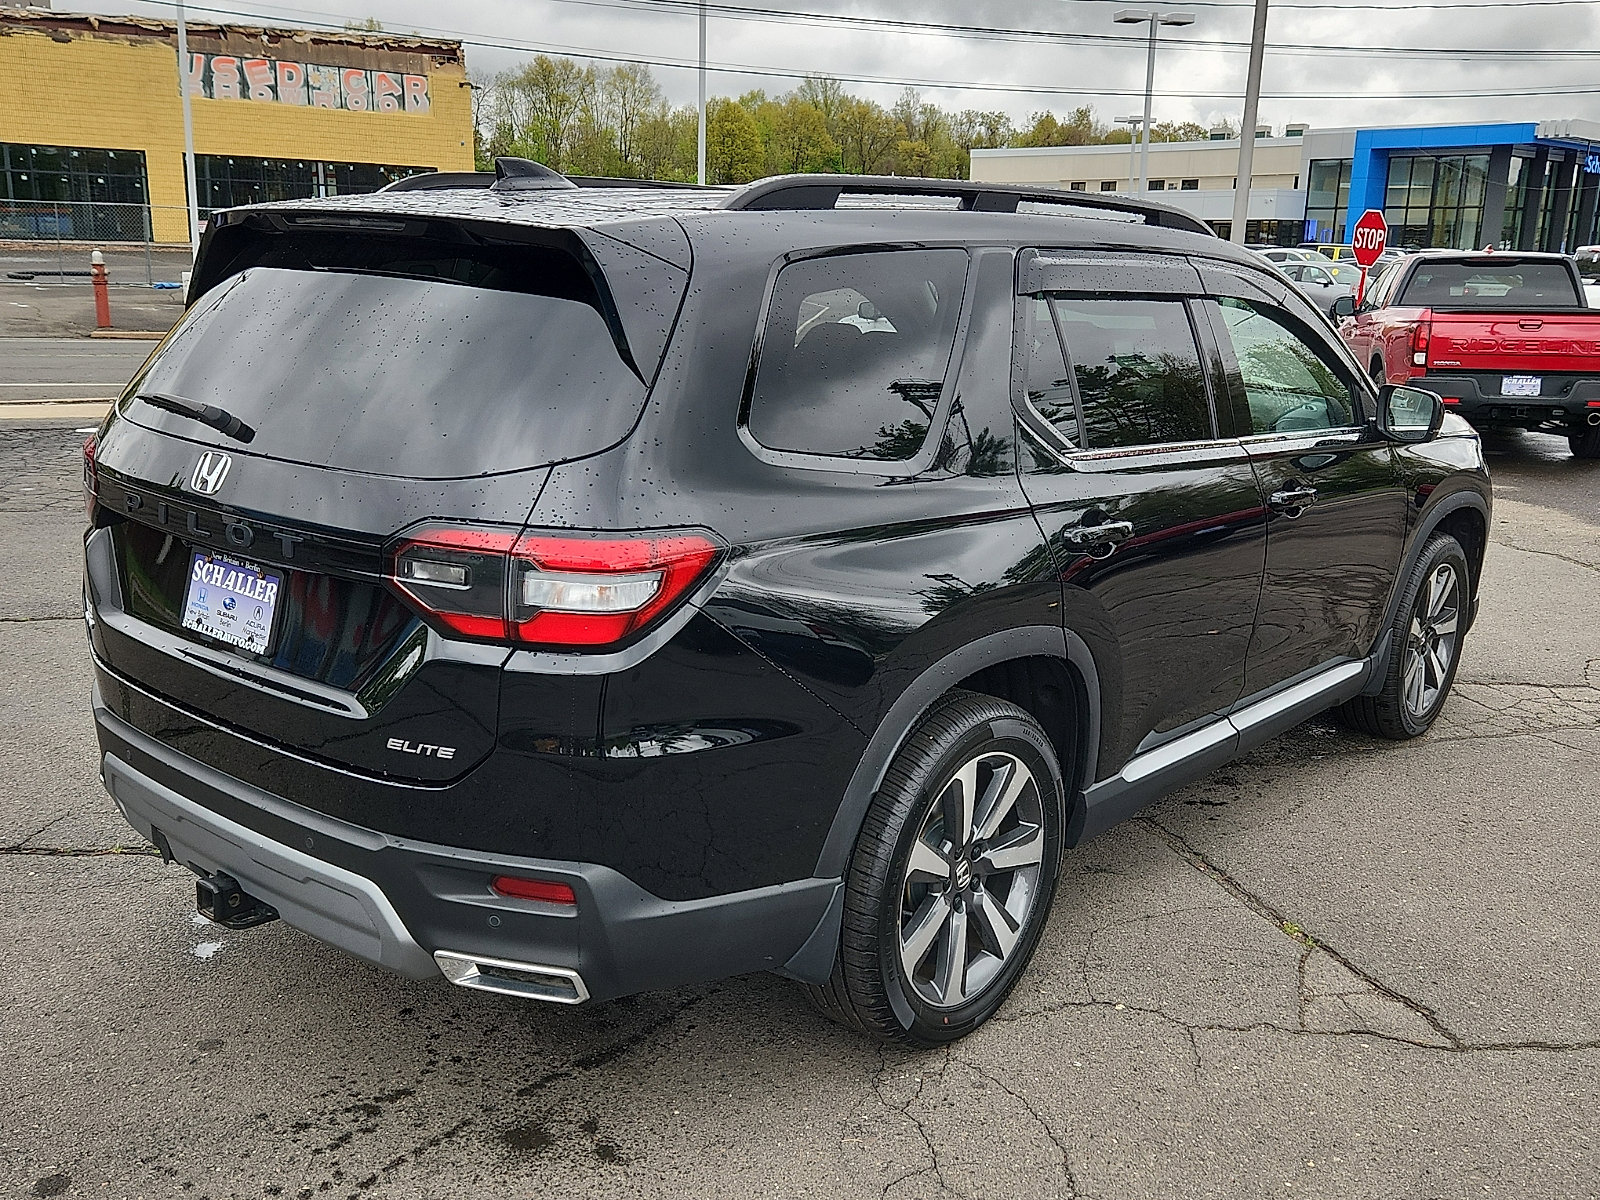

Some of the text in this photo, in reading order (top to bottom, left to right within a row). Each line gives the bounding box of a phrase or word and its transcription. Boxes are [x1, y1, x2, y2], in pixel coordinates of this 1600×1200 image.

[184, 53, 428, 99] USED CAR
[1355, 227, 1384, 250] STOP
[1448, 338, 1600, 354] RIDGELINE
[1502, 377, 1541, 385] SCHALLER
[124, 491, 304, 558] PILOT
[211, 550, 261, 572] New Britain Berlin
[192, 559, 278, 607] SCHALLER
[191, 601, 209, 611] HONDA
[216, 609, 238, 621] SUBARU
[245, 620, 266, 631] ACURA
[181, 618, 267, 655] SCHALLERAUTO.COM
[387, 738, 457, 759] ELITE
